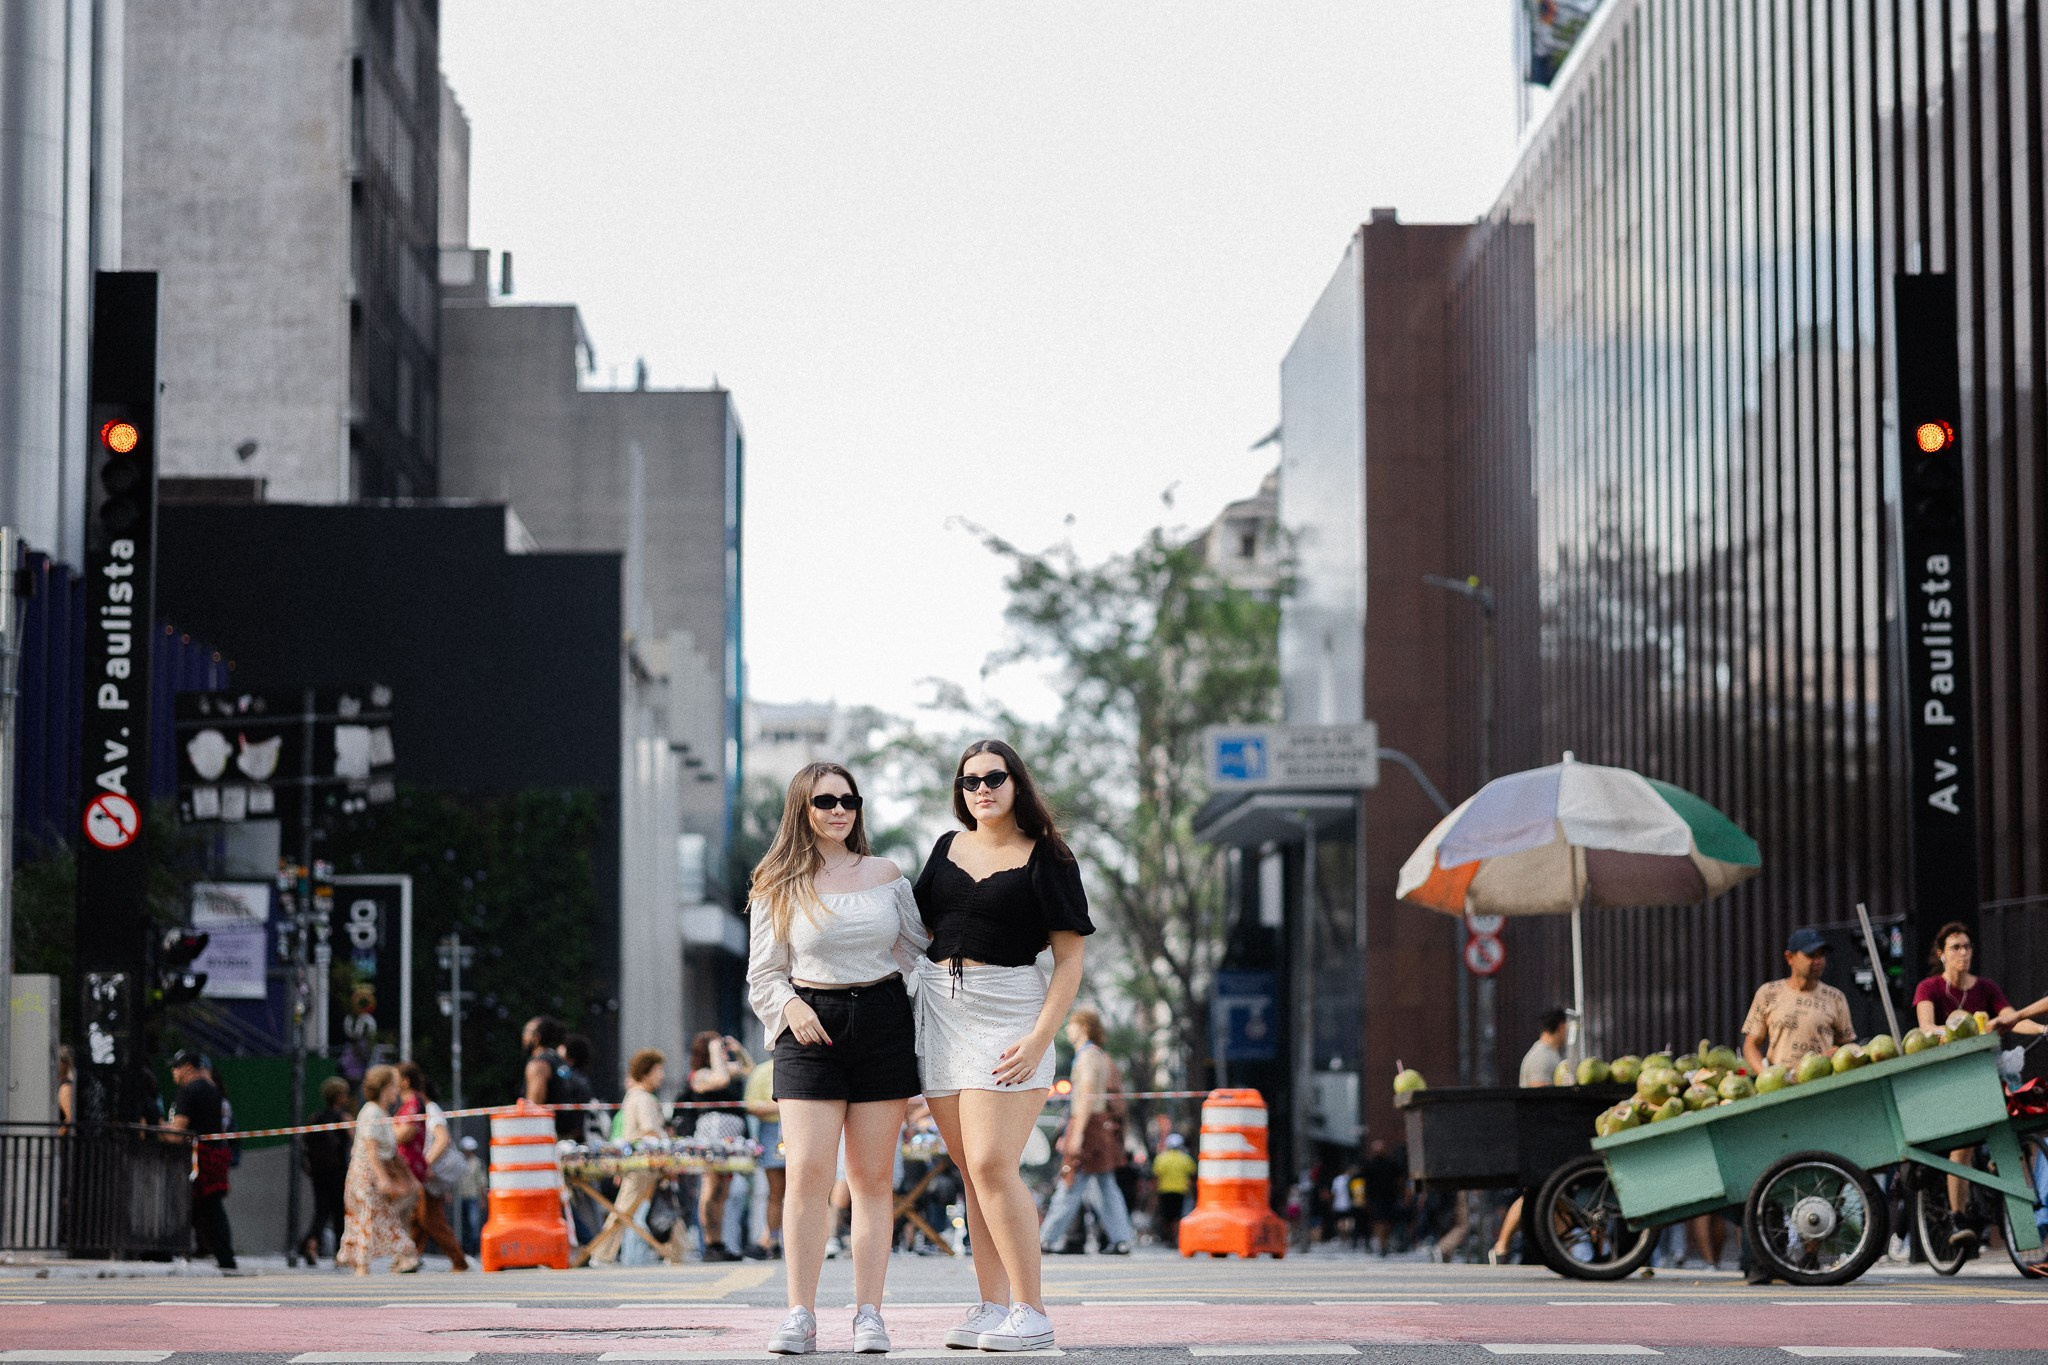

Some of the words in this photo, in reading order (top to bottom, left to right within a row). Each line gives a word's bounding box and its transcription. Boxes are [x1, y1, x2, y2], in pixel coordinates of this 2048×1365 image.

[98, 538, 135, 709] Paulista
[1921, 553, 1956, 725] Paulista
[96, 727, 130, 797] Av.
[1927, 745, 1960, 815] Av.
